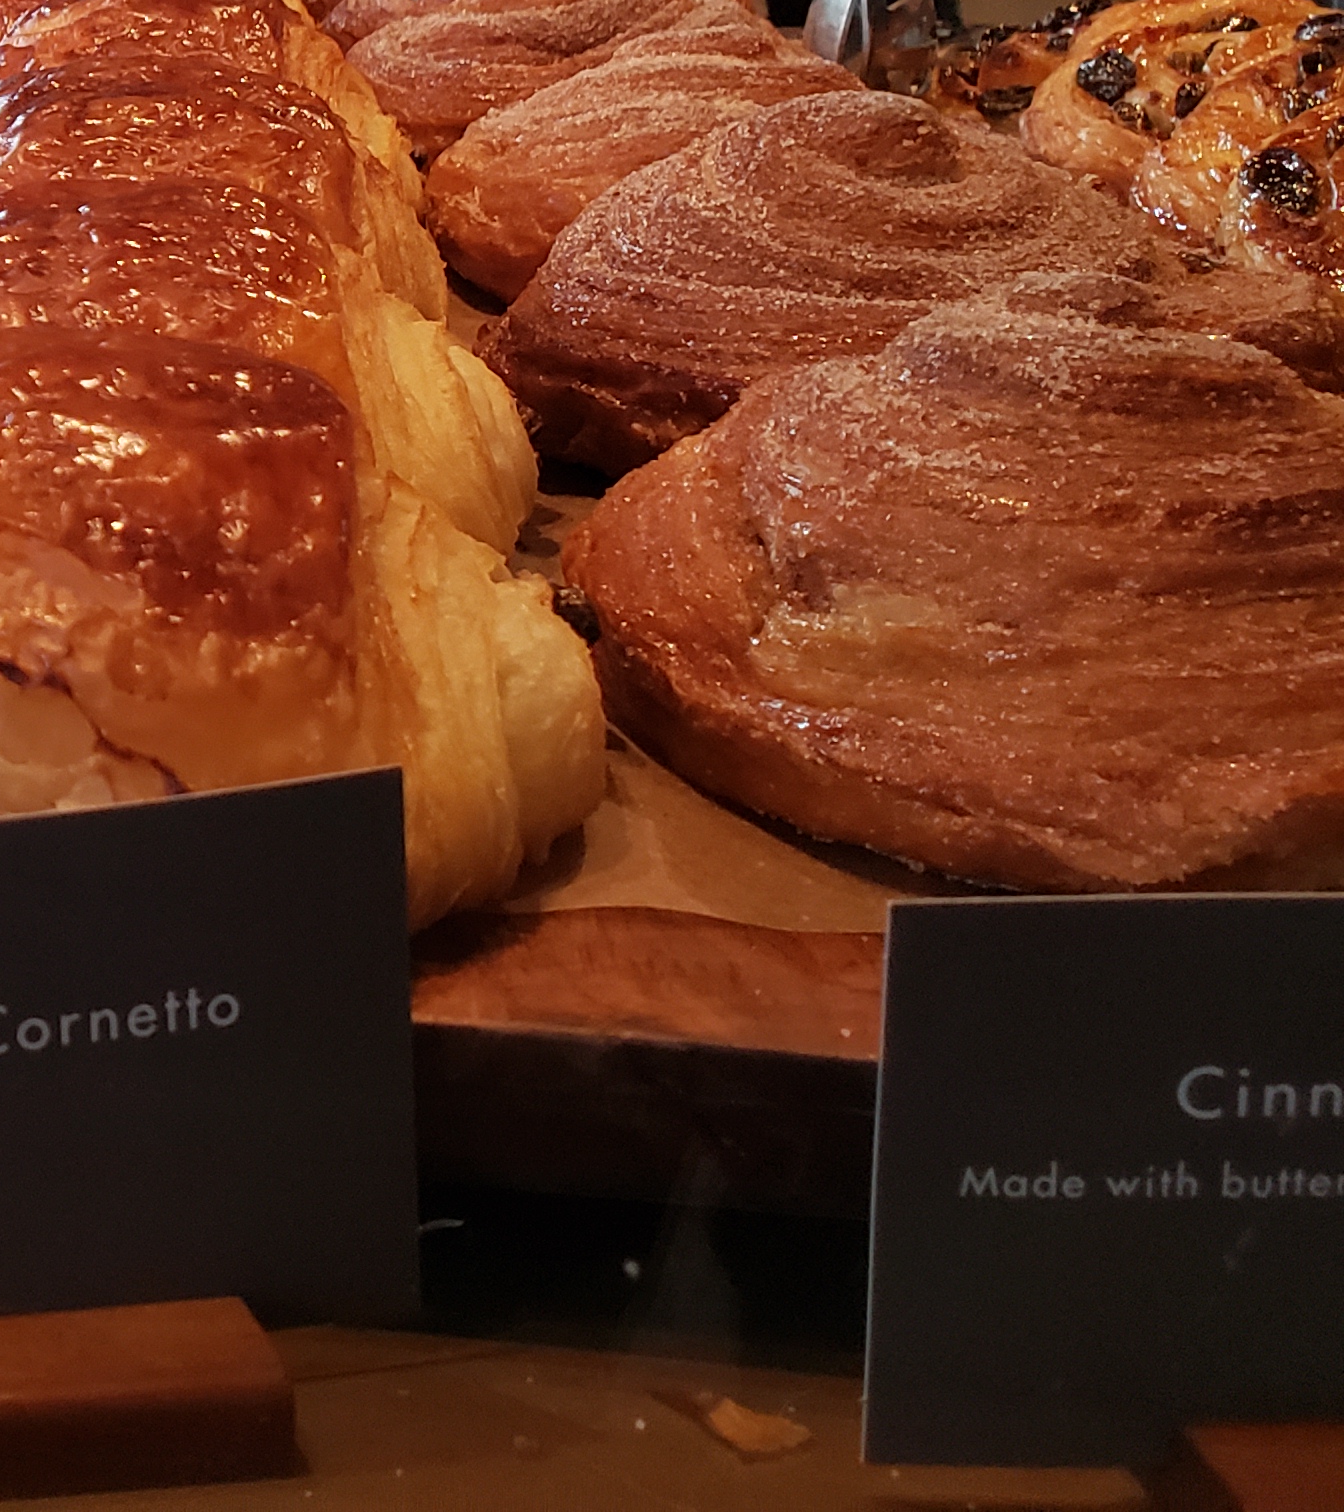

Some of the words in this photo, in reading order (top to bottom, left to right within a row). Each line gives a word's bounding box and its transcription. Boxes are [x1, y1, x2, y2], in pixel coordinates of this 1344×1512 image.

[1176, 1063, 1344, 1121] Cinn
[958, 1159, 1087, 1200] Made
[1104, 1159, 1201, 1199] with
